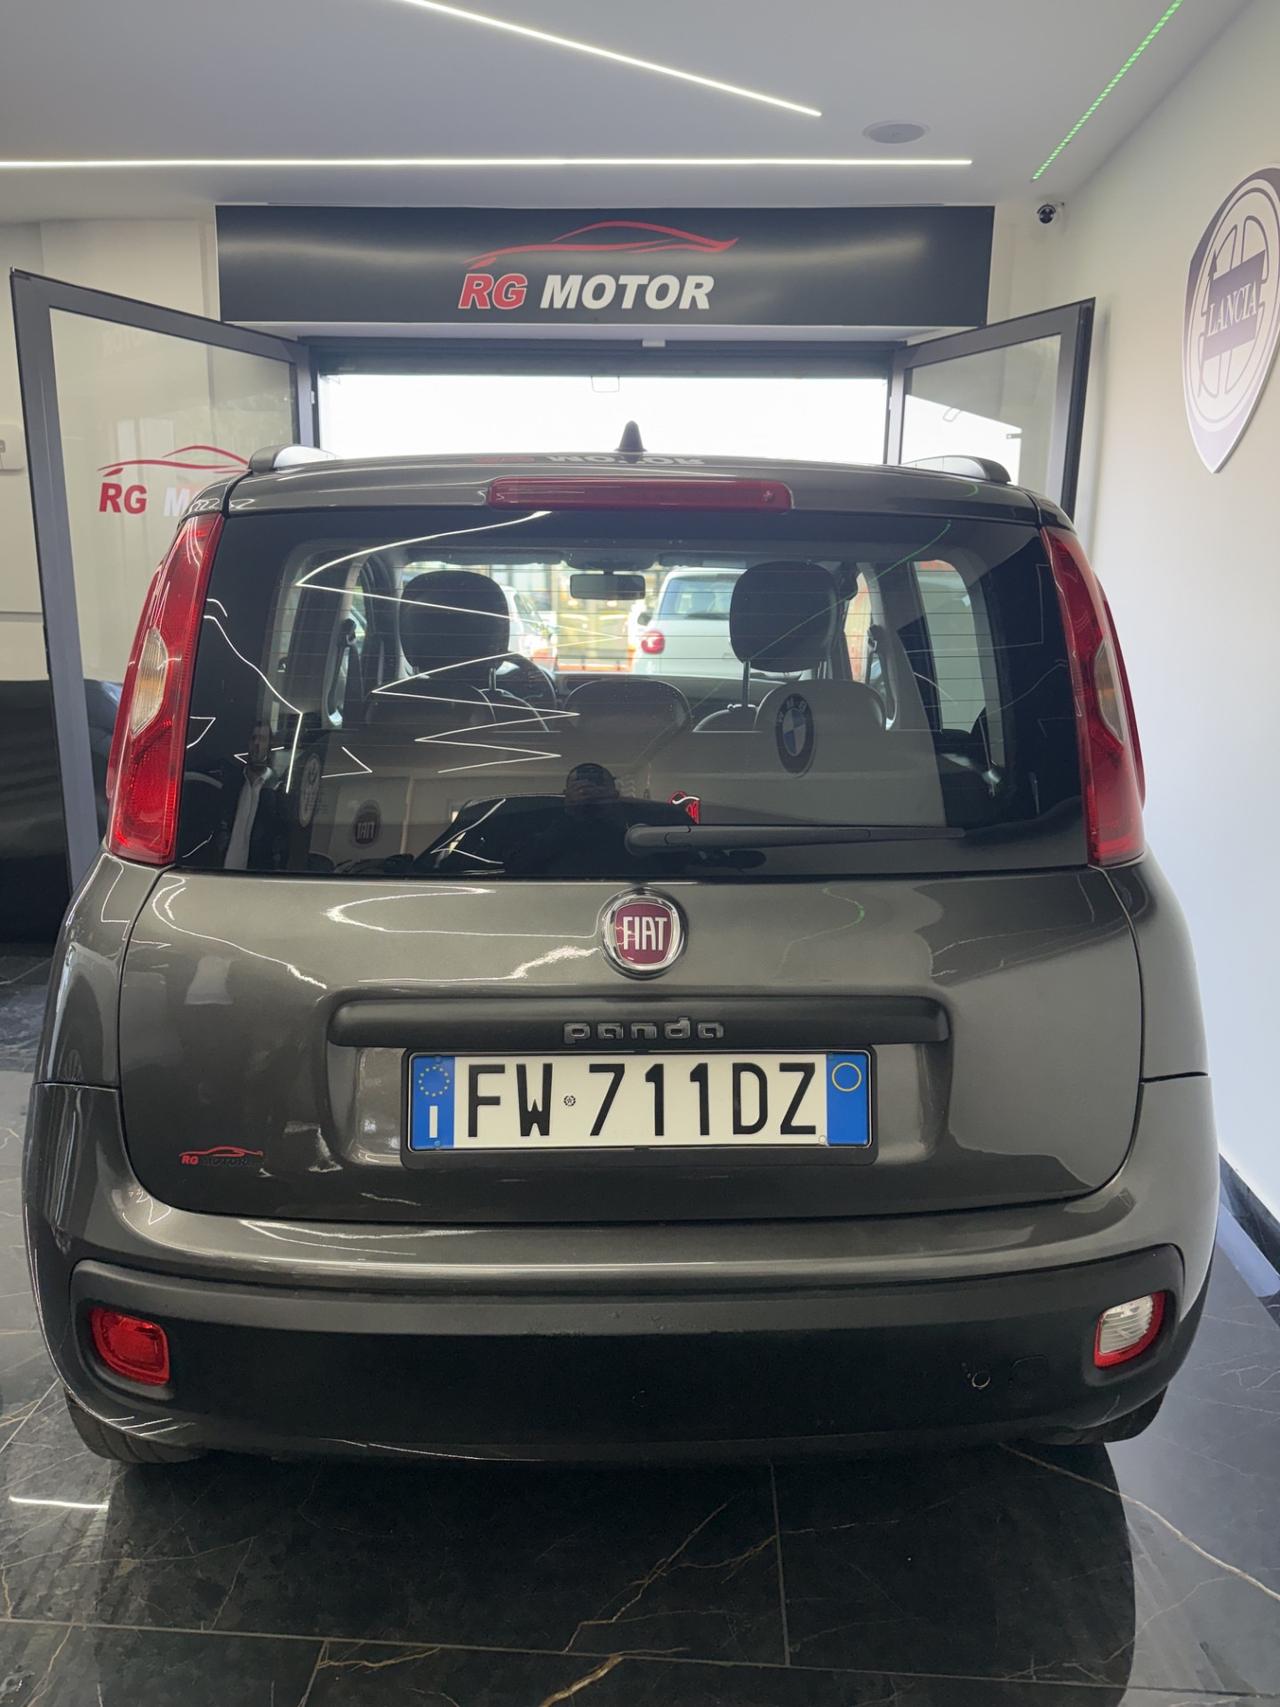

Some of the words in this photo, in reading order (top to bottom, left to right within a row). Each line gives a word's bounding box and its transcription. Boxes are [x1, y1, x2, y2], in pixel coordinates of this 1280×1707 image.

[457, 273, 528, 310] RG
[539, 274, 715, 310] MOTOR
[1208, 281, 1257, 336] LANCIA
[99, 482, 147, 514] RG
[622, 916, 668, 951] FIAT
[563, 1017, 725, 1044] panda
[467, 1062, 554, 1138] FW
[588, 1062, 817, 1136] 711DZ
